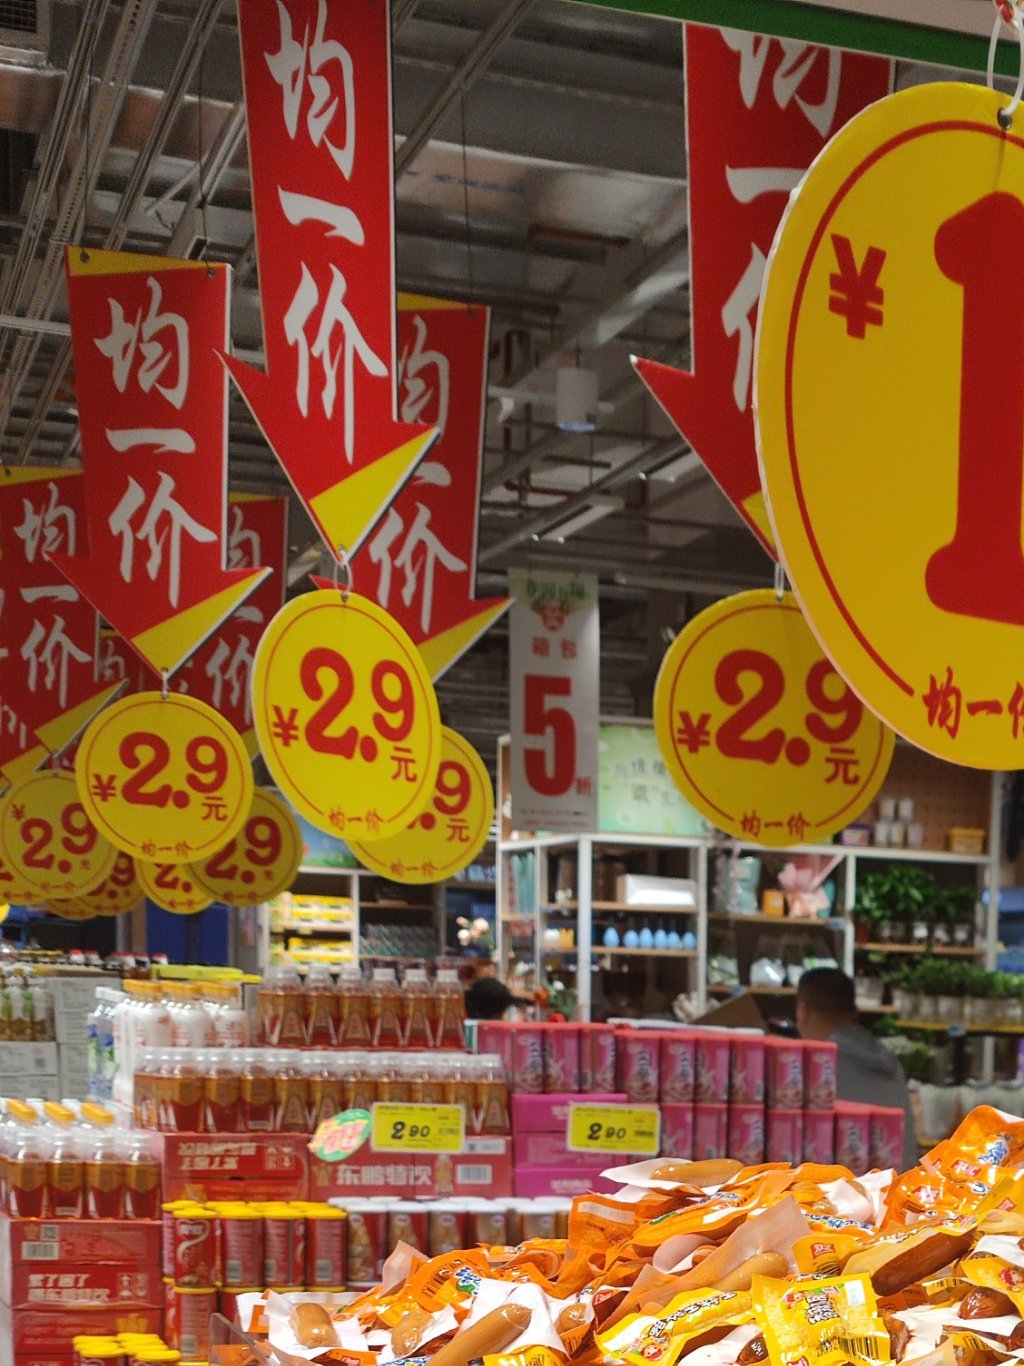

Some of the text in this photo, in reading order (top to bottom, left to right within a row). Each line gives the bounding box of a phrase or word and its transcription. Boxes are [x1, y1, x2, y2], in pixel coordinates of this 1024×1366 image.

[264, 0, 389, 464] 均一价
[94, 277, 218, 608] 均一价
[13, 481, 93, 709] 均一价
[328, 806, 386, 834] 均一价
[739, 813, 811, 839] 均一价
